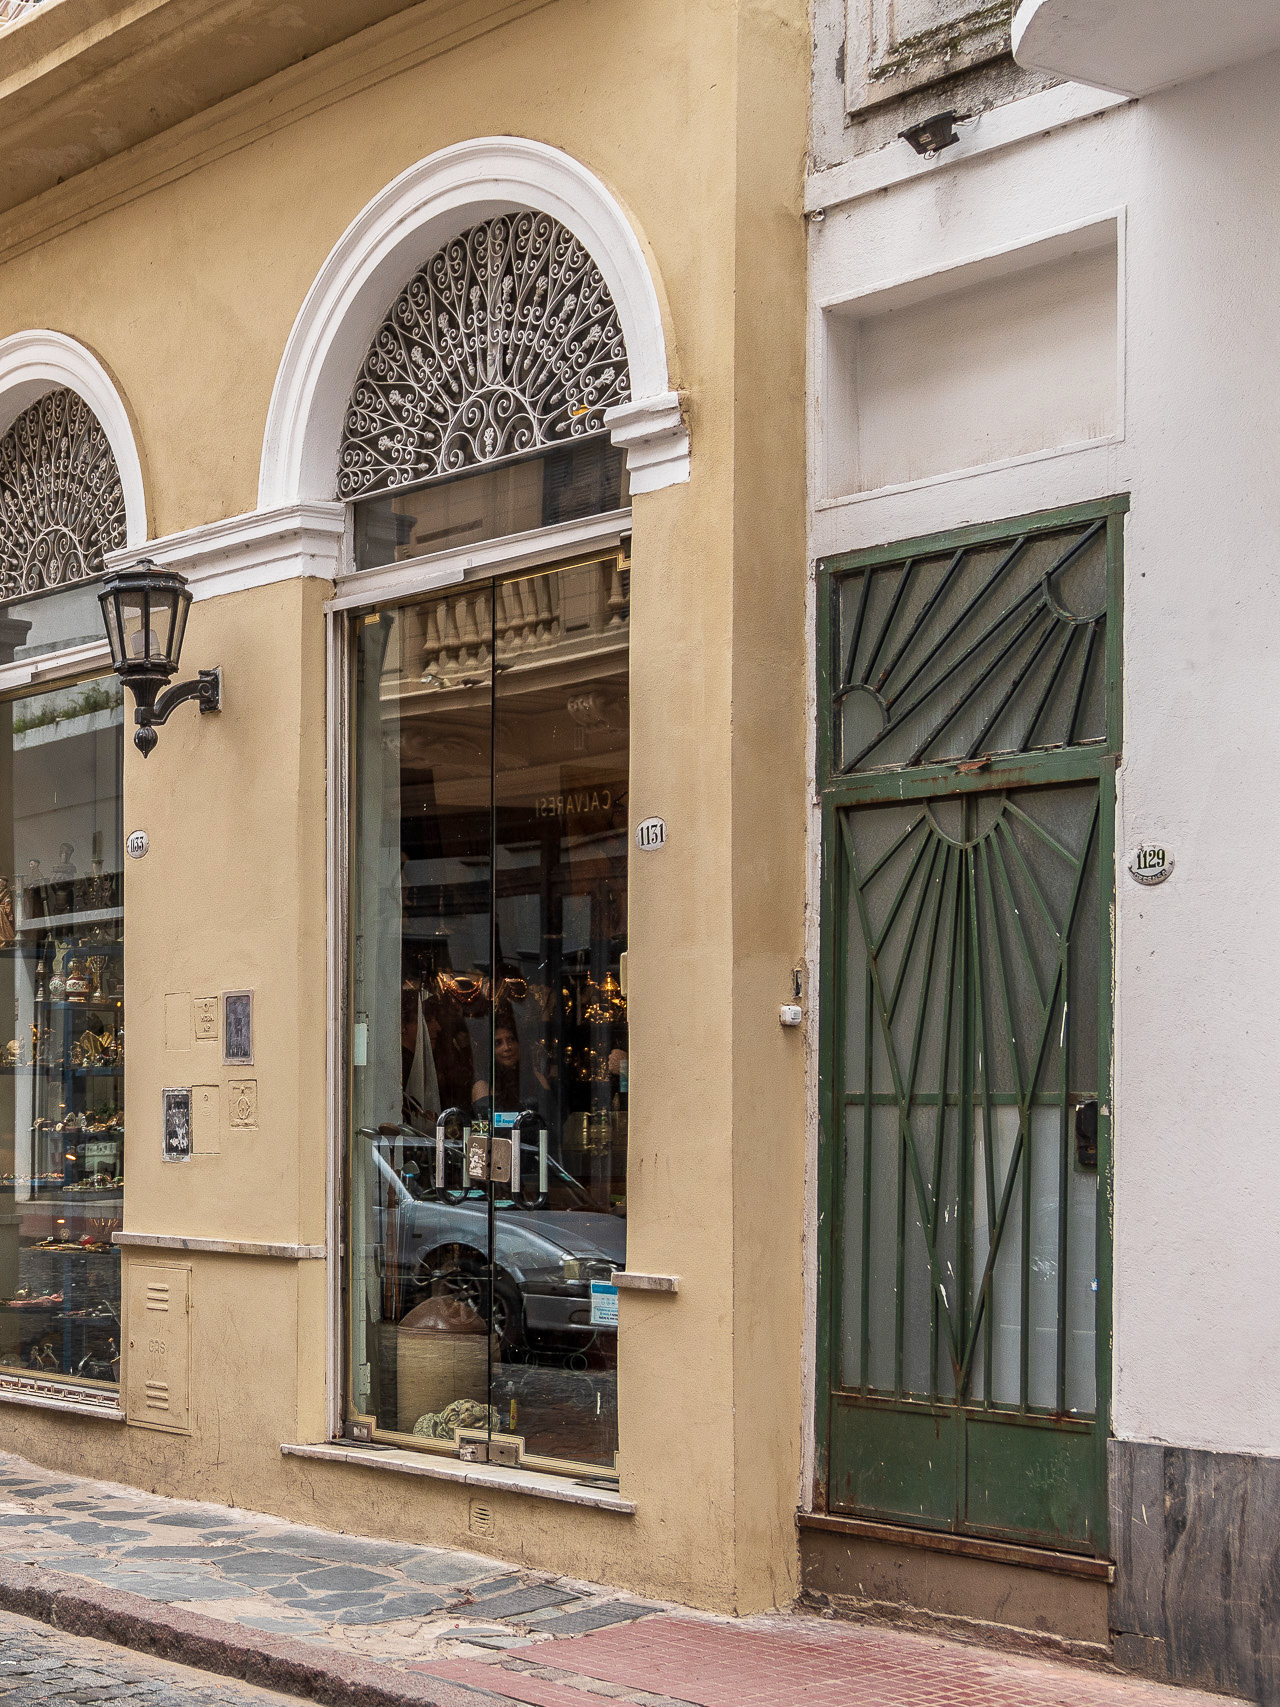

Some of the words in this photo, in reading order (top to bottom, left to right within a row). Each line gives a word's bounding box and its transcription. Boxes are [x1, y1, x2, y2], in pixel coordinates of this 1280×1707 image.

[639, 822, 665, 847] 1131
[130, 836, 145, 853] 1133
[1136, 848, 1166, 870] 1129
[148, 1338, 166, 1354] GAS
